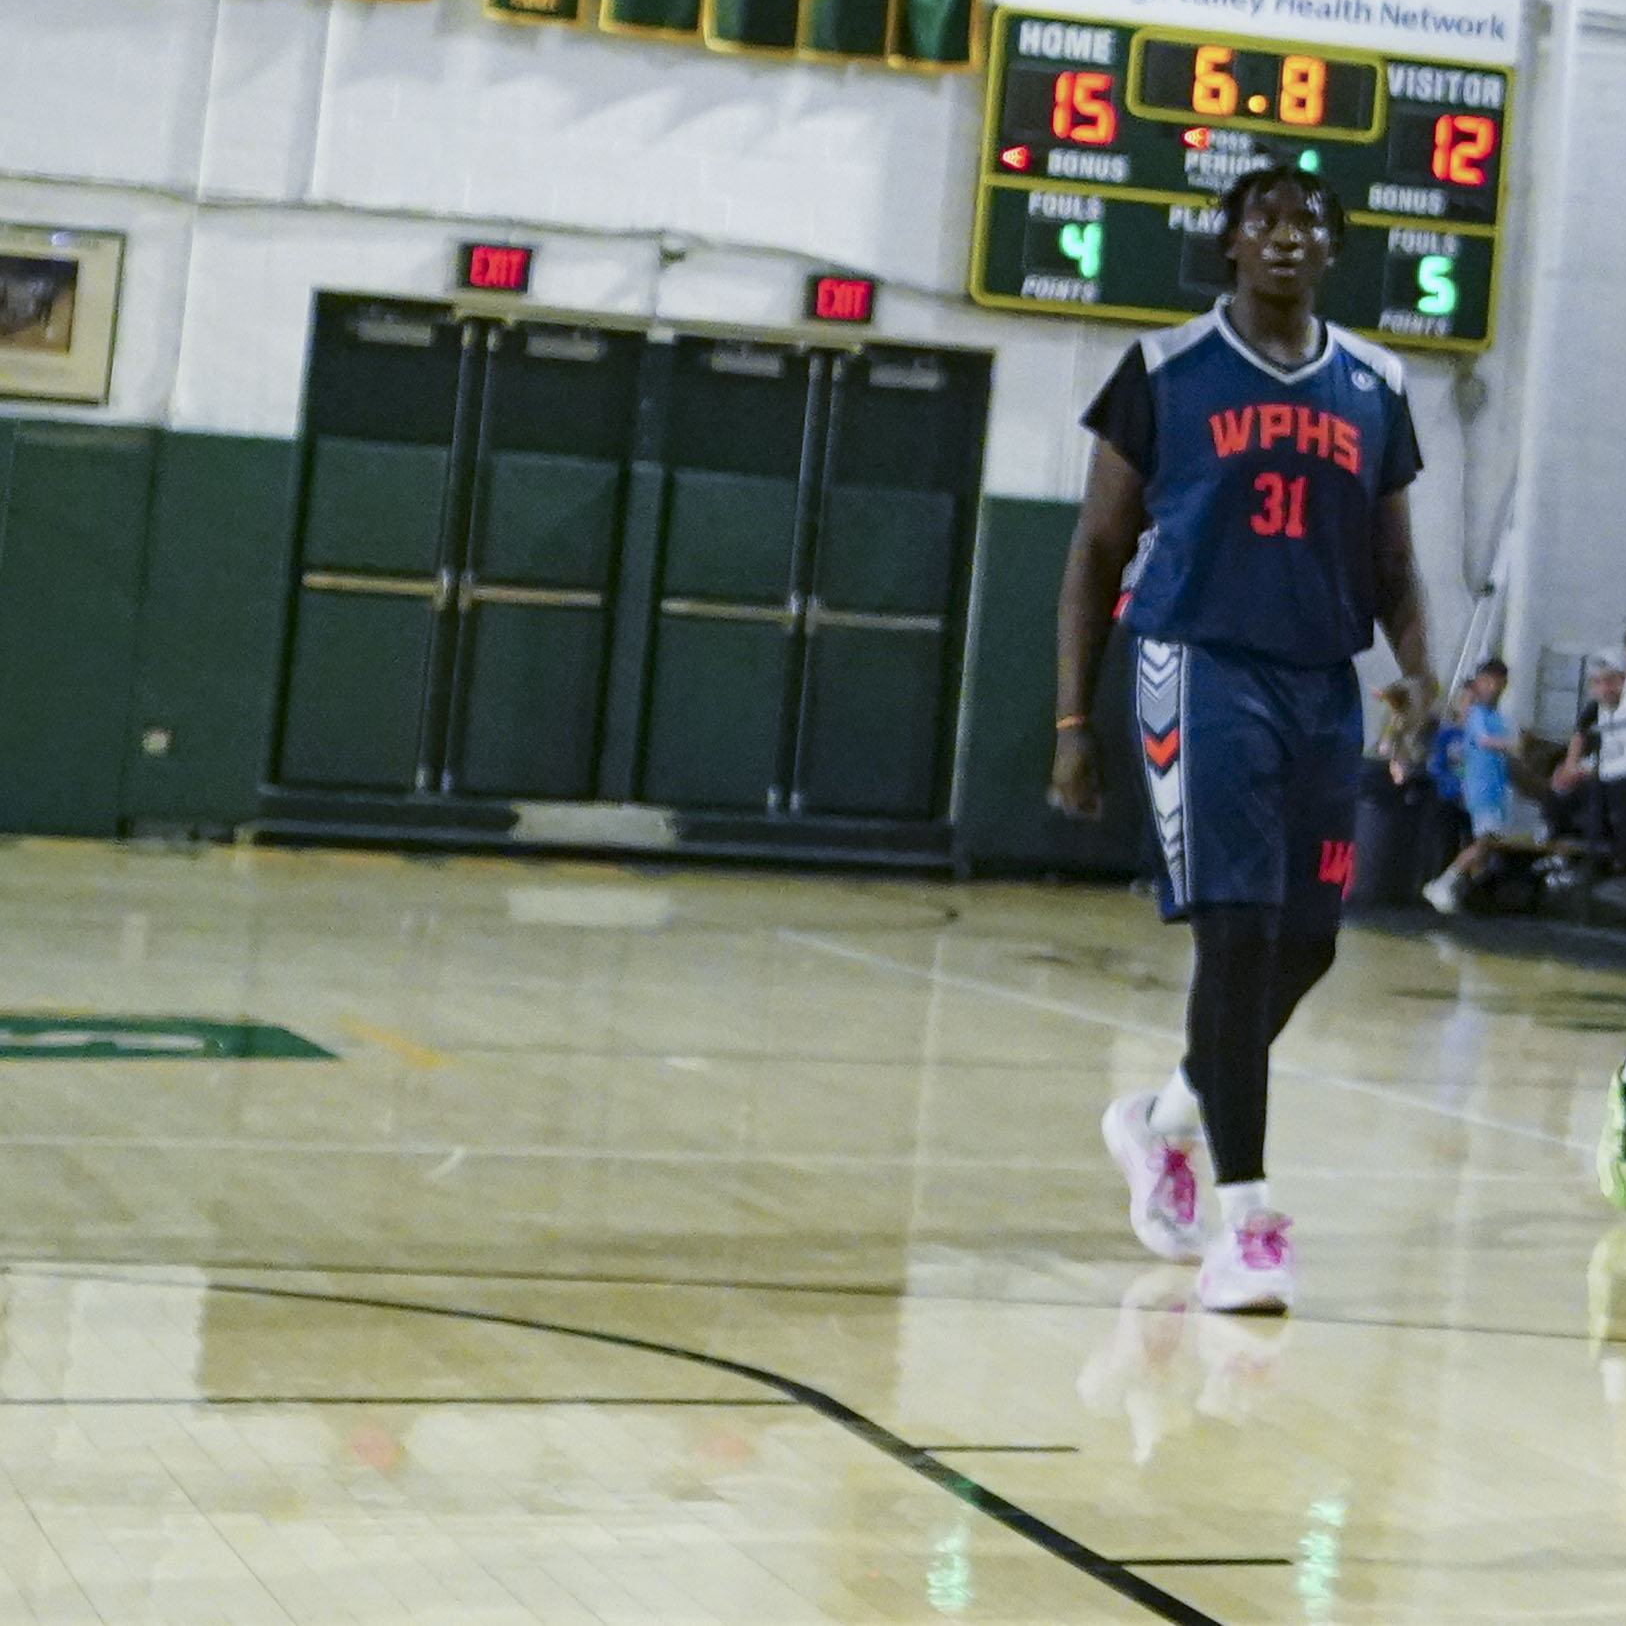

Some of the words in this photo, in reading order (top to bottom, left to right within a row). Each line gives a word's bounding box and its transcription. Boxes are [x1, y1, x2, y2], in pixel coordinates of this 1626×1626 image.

[1018, 19, 1117, 66] HOME
[1380, 0, 1506, 40] Network
[1052, 70, 1117, 146] 15
[1192, 44, 1326, 125] 6.8
[1386, 60, 1505, 109] VISITOR
[1047, 146, 1130, 183] BONUS
[1431, 113, 1497, 188] 12
[1027, 189, 1104, 223] FOULS
[1367, 181, 1449, 218] BONUS
[1058, 222, 1104, 279] 4
[1386, 227, 1462, 257] FOULS
[470, 244, 529, 291] EXIT
[1417, 254, 1458, 316] 5
[816, 276, 873, 322] EXIT
[1206, 402, 1362, 475] WPHS
[1249, 470, 1308, 539] 31
